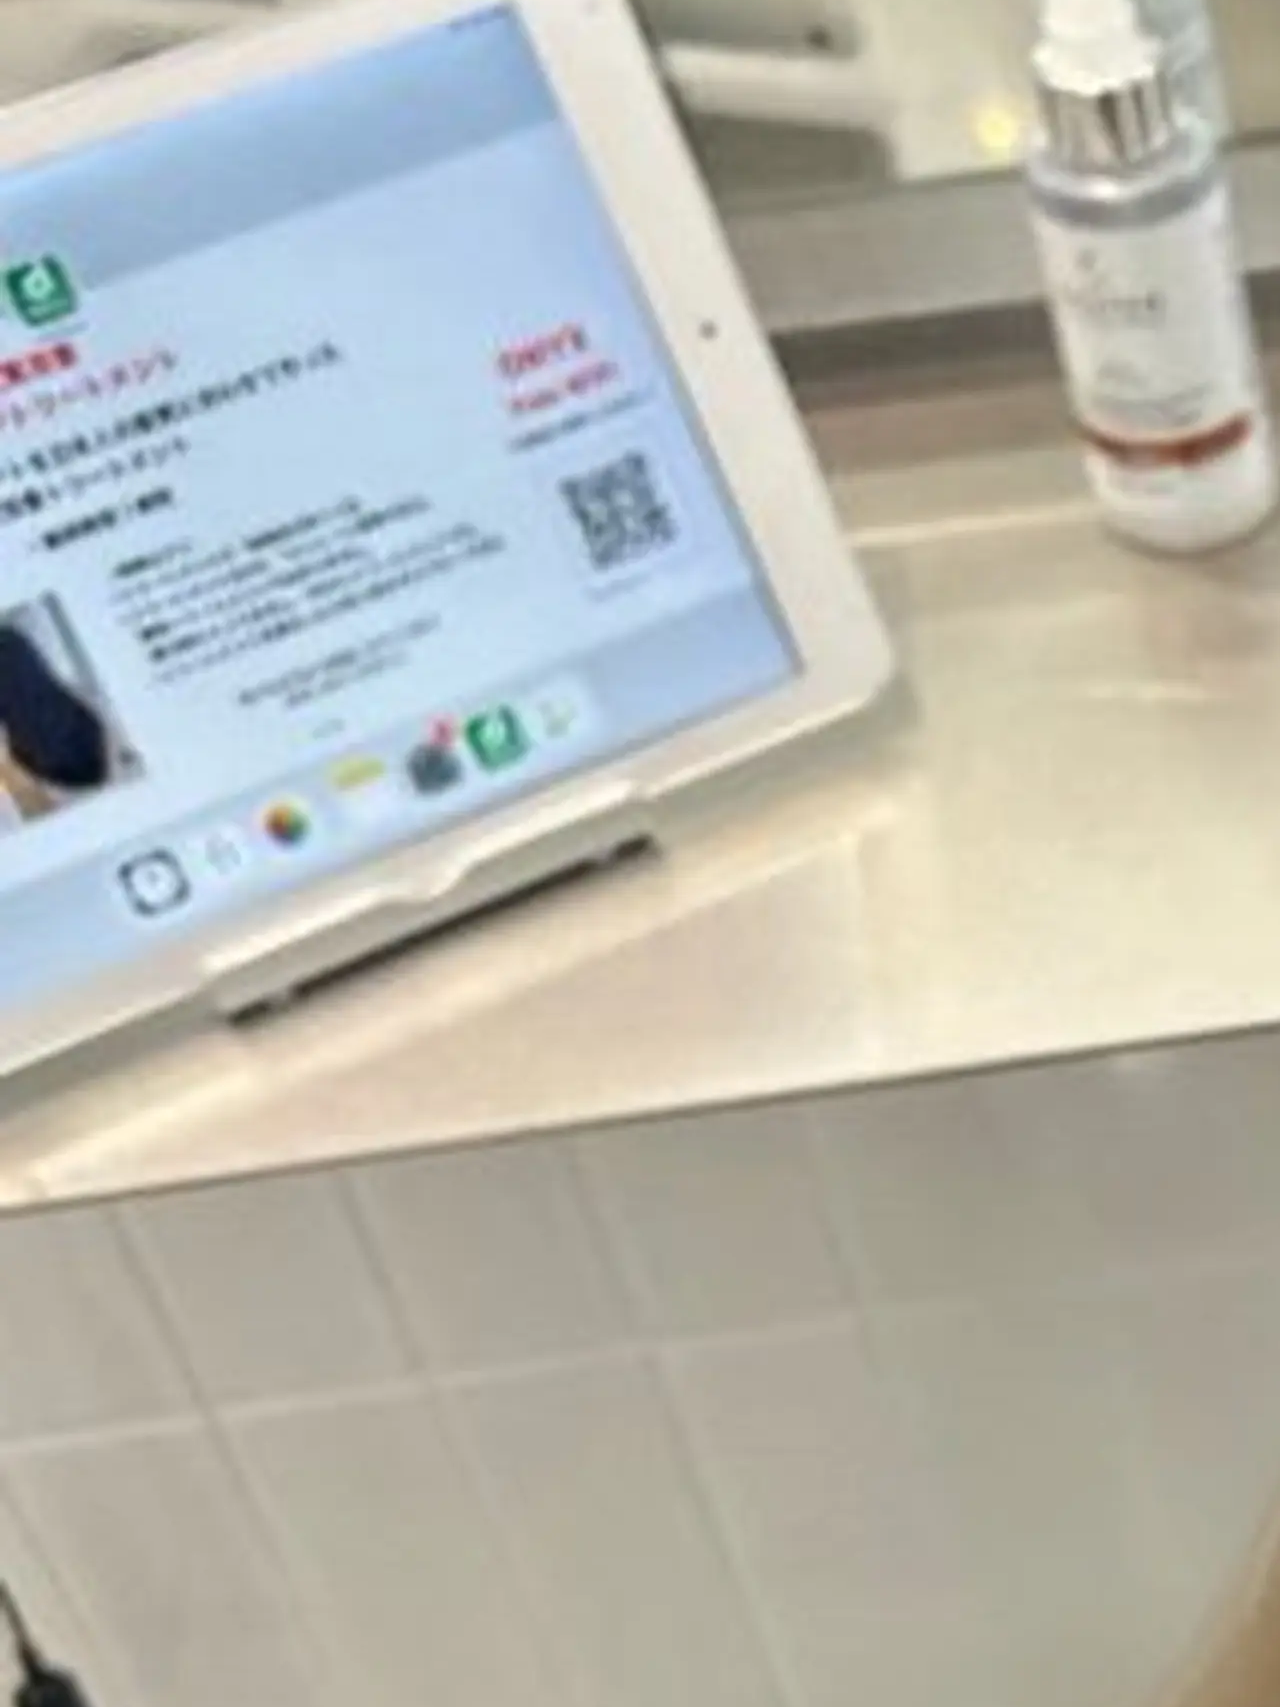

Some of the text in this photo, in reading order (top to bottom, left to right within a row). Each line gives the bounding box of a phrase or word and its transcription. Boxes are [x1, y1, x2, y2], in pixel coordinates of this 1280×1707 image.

[0, 349, 177, 430] トリートメント
